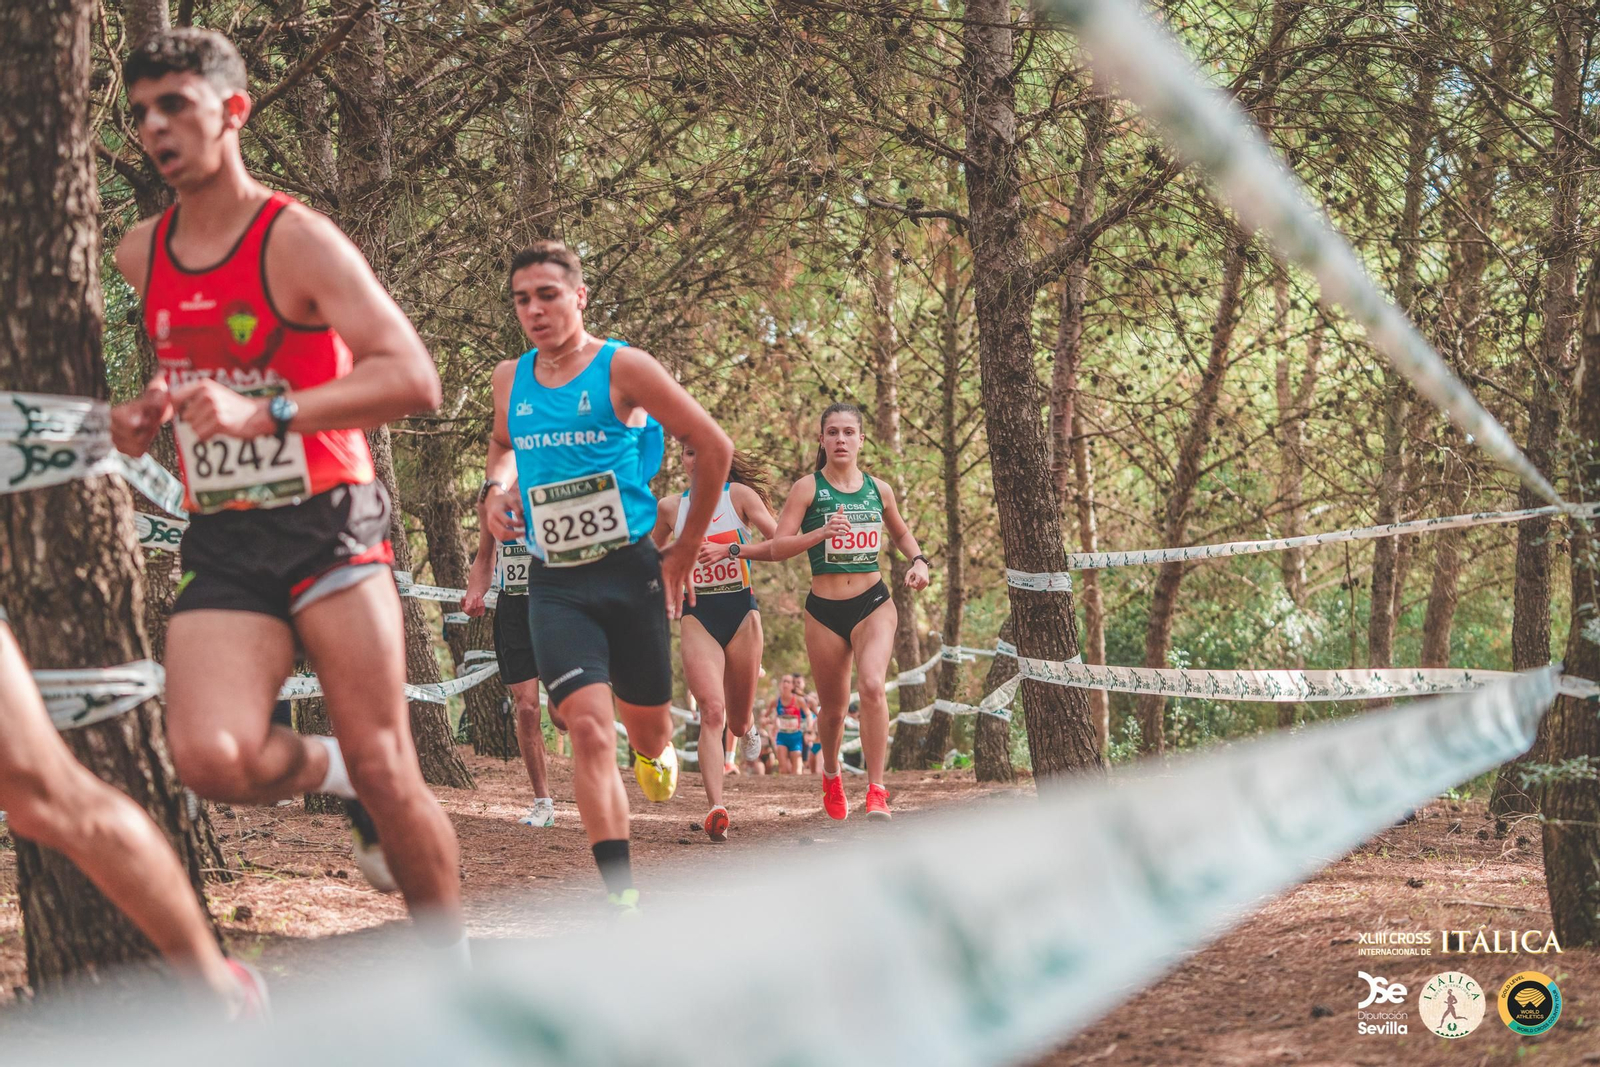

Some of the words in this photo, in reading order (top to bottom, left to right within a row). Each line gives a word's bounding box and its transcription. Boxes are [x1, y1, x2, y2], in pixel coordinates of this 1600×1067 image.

[193, 437, 294, 478] 8242
[542, 505, 618, 545] 8283
[831, 530, 878, 550] 6300
[693, 562, 738, 584] 6306
